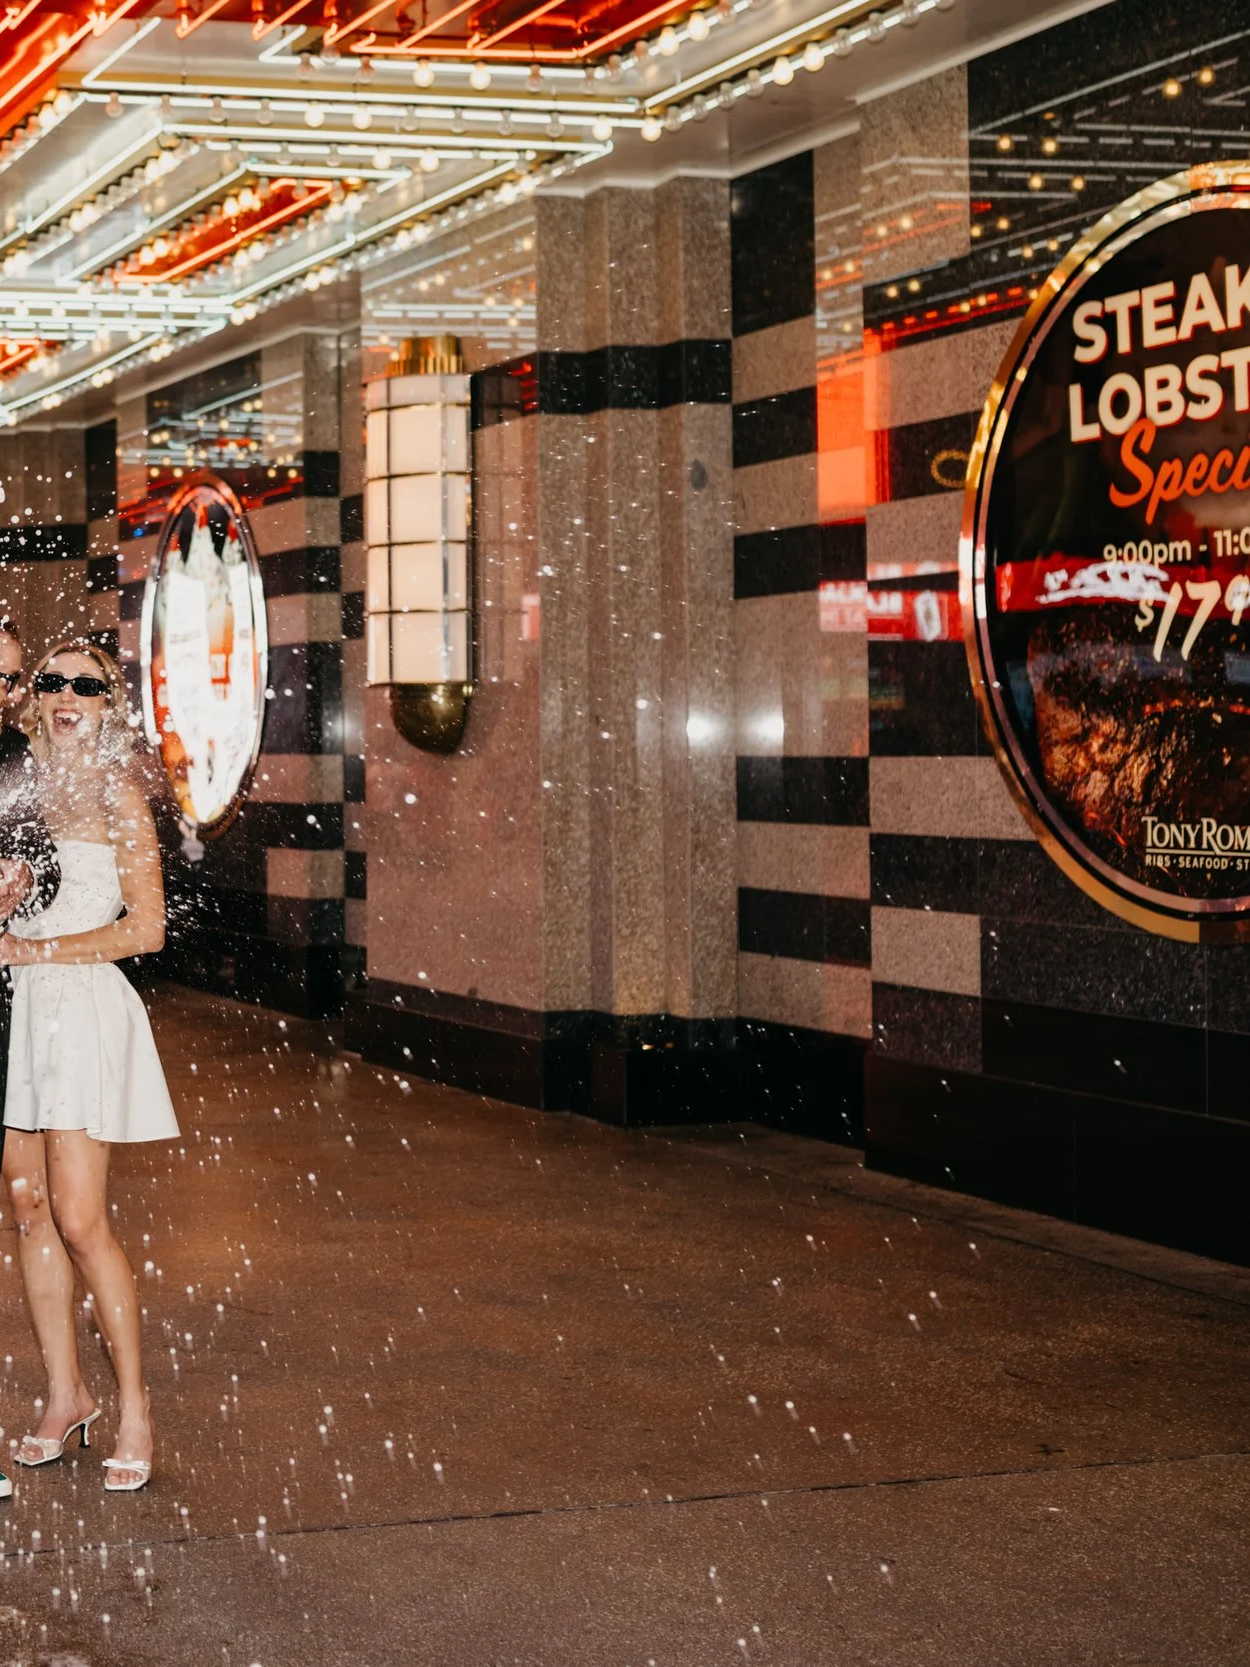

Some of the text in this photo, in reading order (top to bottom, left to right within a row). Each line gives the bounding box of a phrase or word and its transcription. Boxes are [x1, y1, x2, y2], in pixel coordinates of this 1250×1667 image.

[1072, 263, 1250, 365] STEAK
[1068, 346, 1250, 445] LOBST
[1145, 854, 1170, 867] RIBS
[1178, 855, 1228, 870] SEAFOOD
